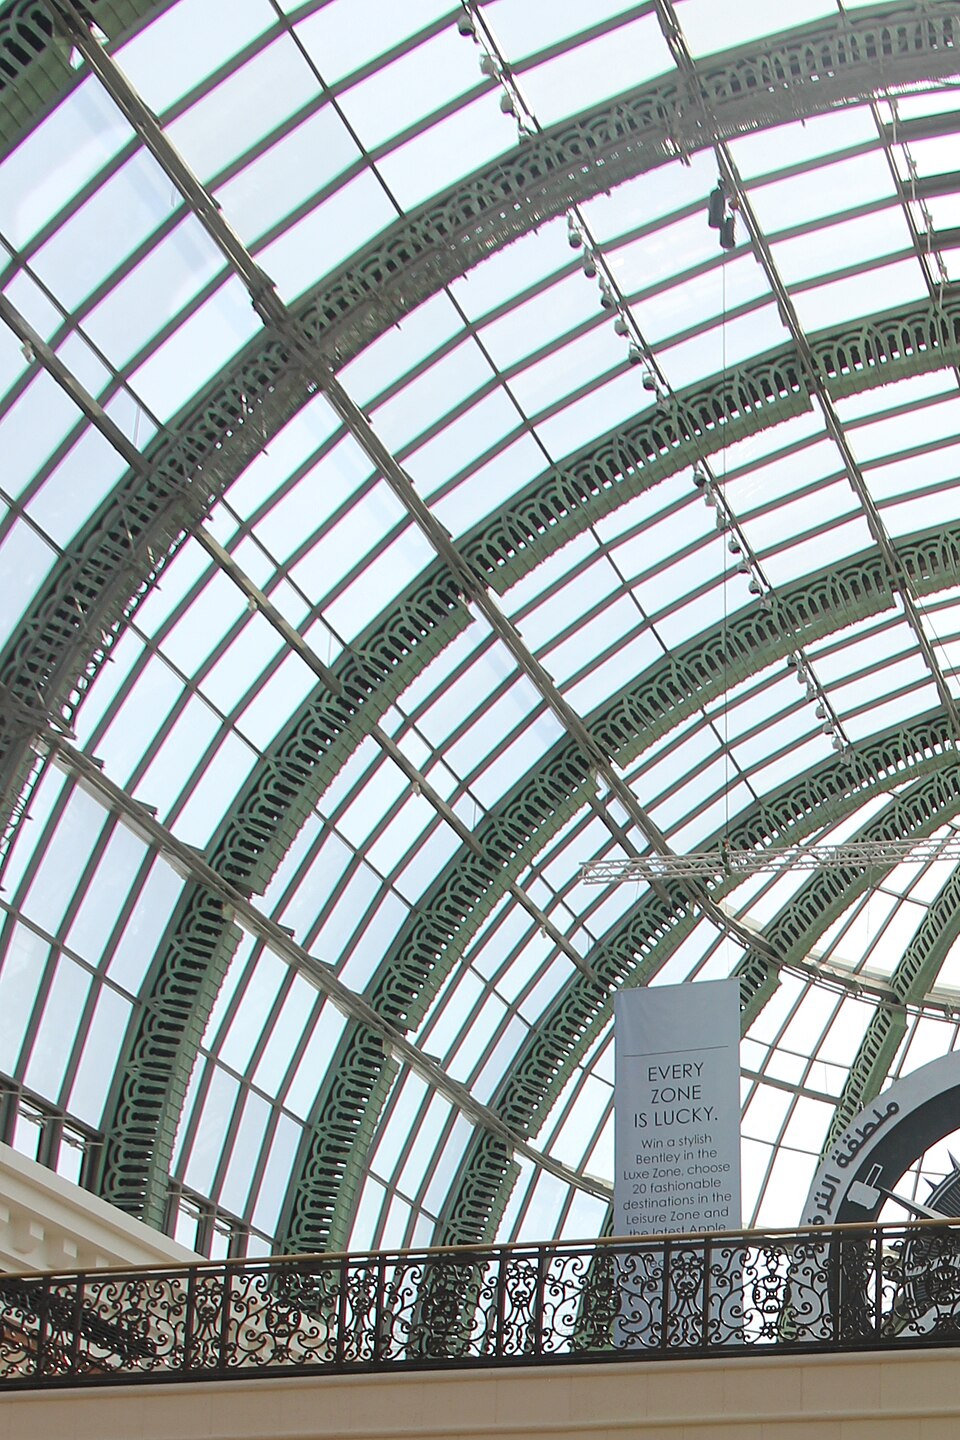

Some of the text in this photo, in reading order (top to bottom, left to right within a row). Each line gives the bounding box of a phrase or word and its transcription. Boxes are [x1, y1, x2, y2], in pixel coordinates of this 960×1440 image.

[648, 1062, 704, 1082] EVERY
[651, 1084, 702, 1104] ZONE
[634, 1106, 718, 1128] IS LUCKY.
[641, 1133, 712, 1149] Win a stylish
[636, 1149, 718, 1165] Bentley in the
[623, 1170, 649, 1181] Luxe
[687, 1163, 730, 1176] choose
[632, 1178, 721, 1194] 20 fashionable
[623, 1191, 732, 1211] destinations in the
[626, 1207, 729, 1225] Leisure Zone and
